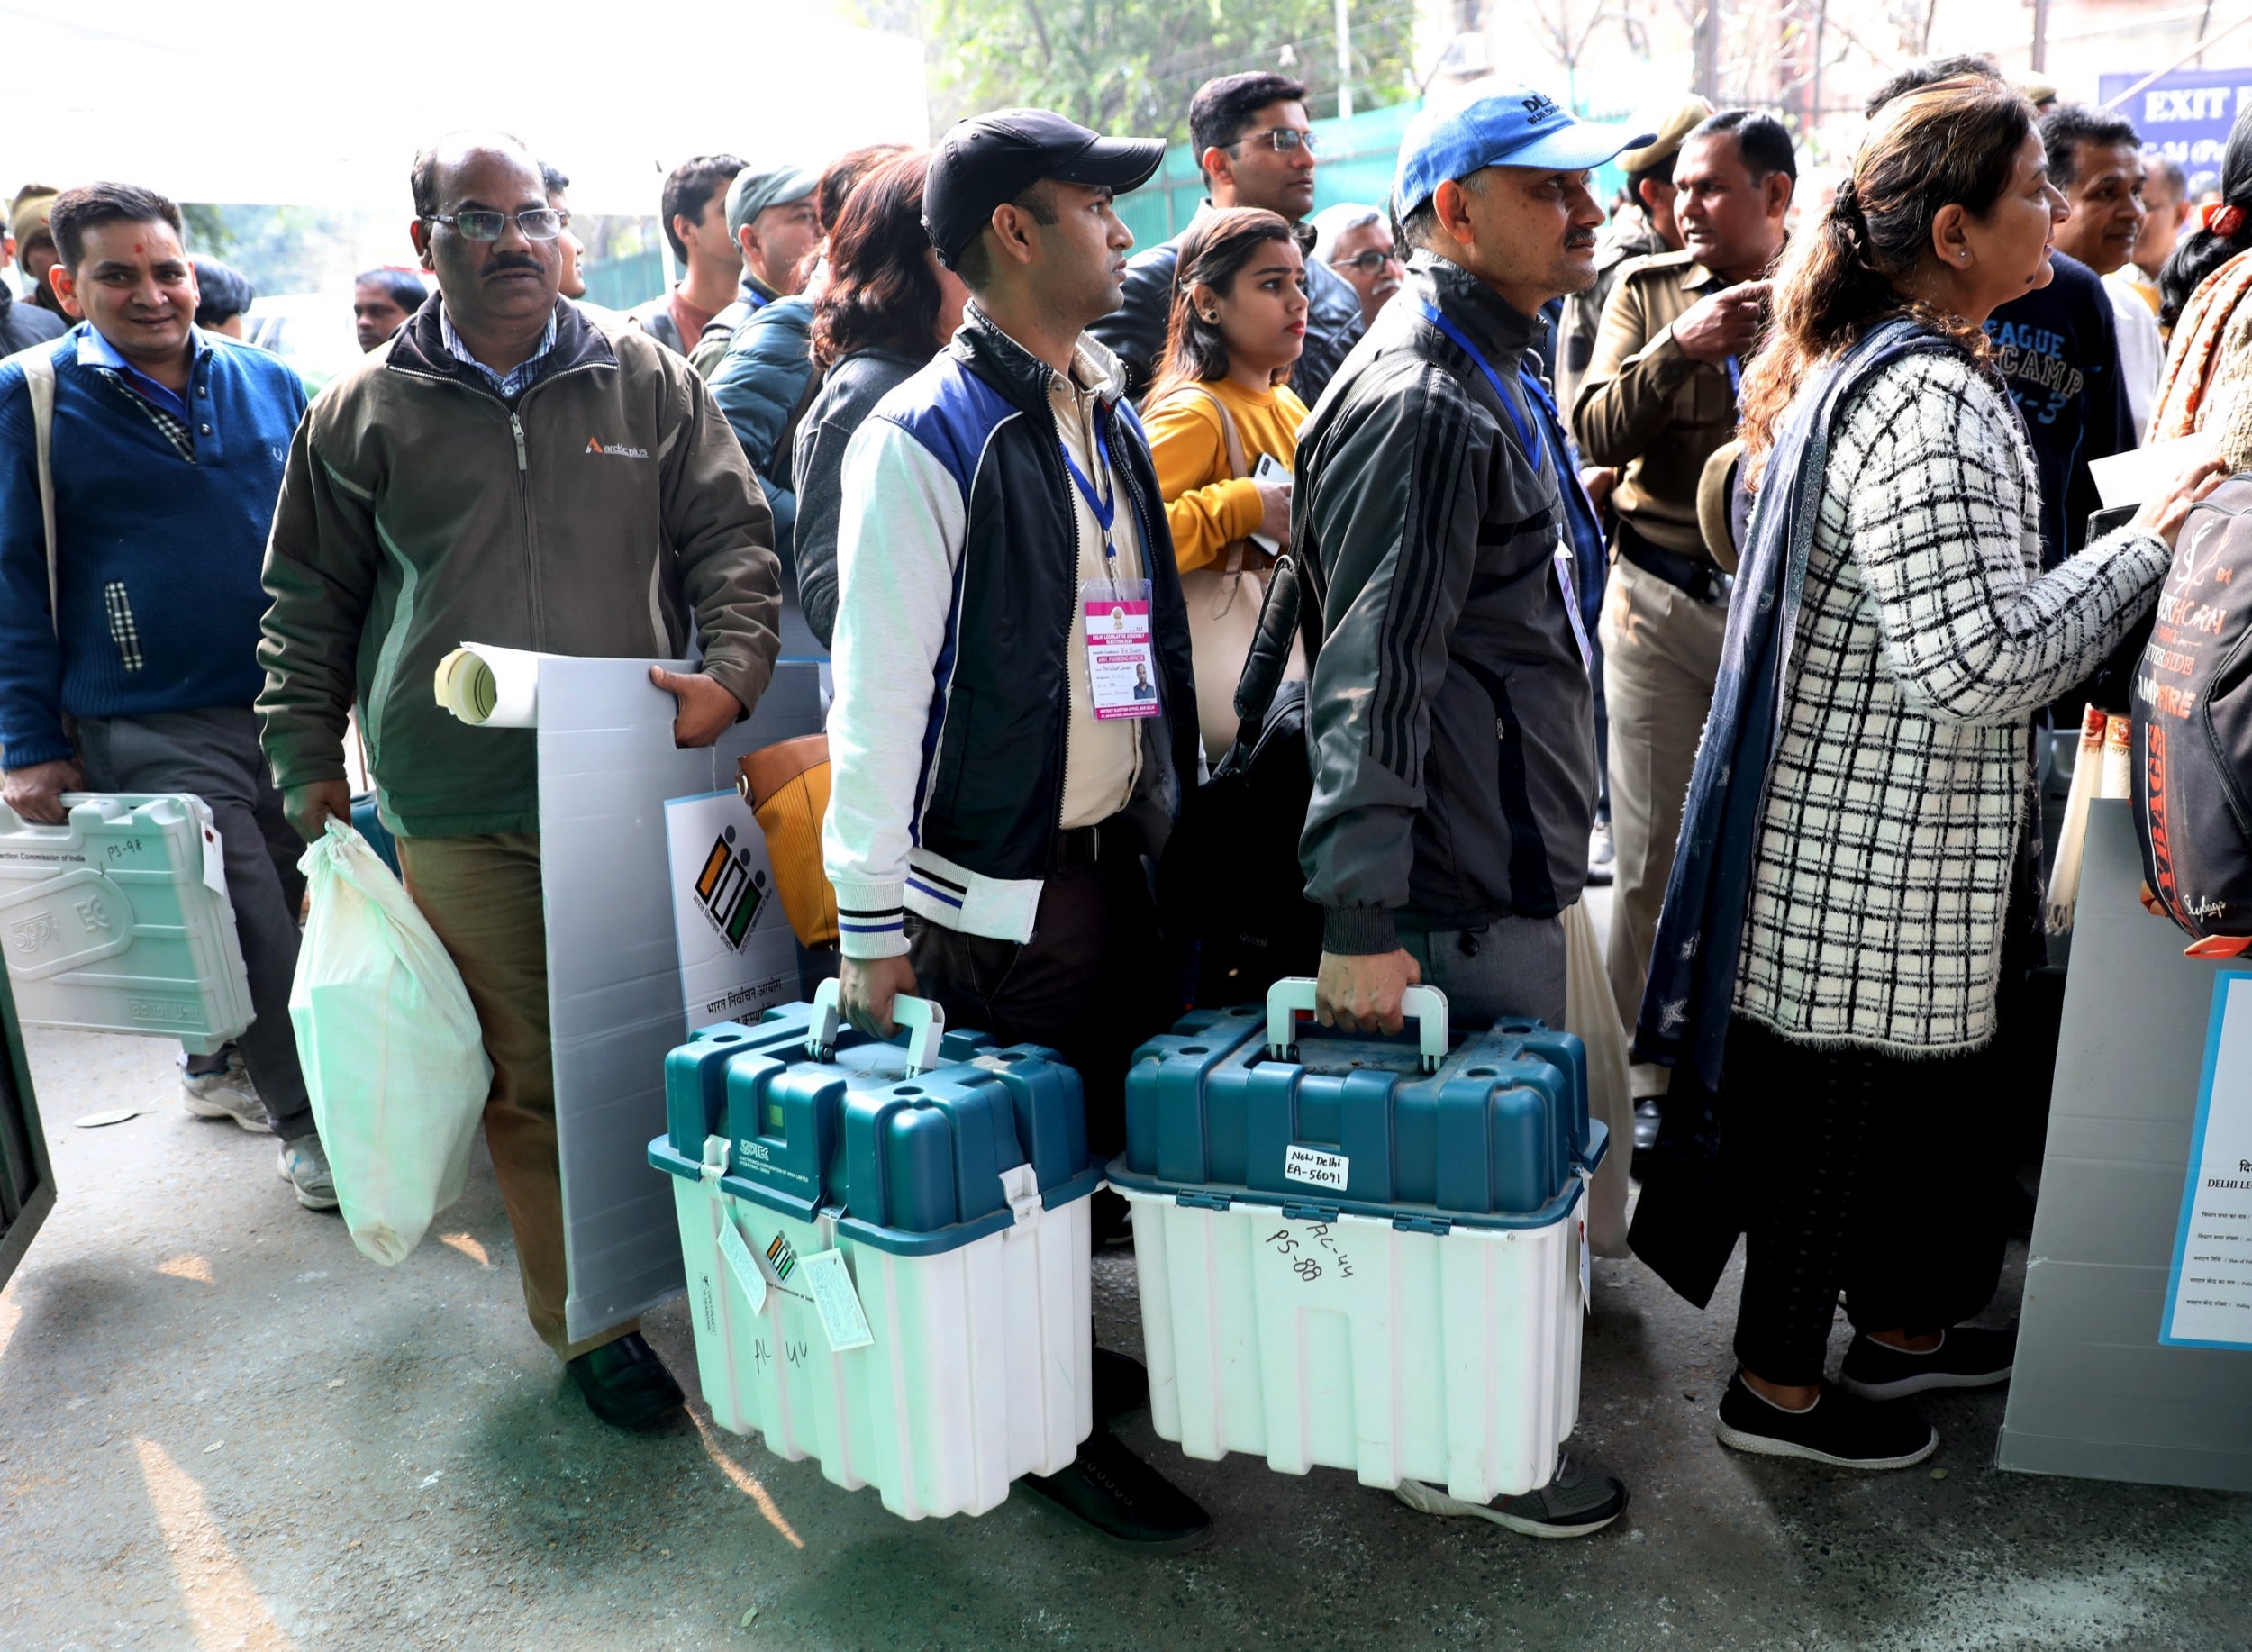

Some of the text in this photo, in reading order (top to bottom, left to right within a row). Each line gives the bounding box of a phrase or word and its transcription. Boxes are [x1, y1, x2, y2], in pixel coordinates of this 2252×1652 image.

[2145, 87, 2230, 122] EXIT
[1998, 344, 2084, 399] CAMP
[2138, 675, 2196, 720] AMPFIRE
[20, 853, 59, 861] Commission
[106, 839, 142, 862] PS-98
[2184, 894, 2227, 924] Skybags
[706, 976, 783, 1015] भारत निर्वाचन आयोग
[1286, 1163, 1341, 1185] EA-56091
[2207, 1178, 2252, 1190] DELHI LE
[1265, 1229, 1323, 1283] PS-88
